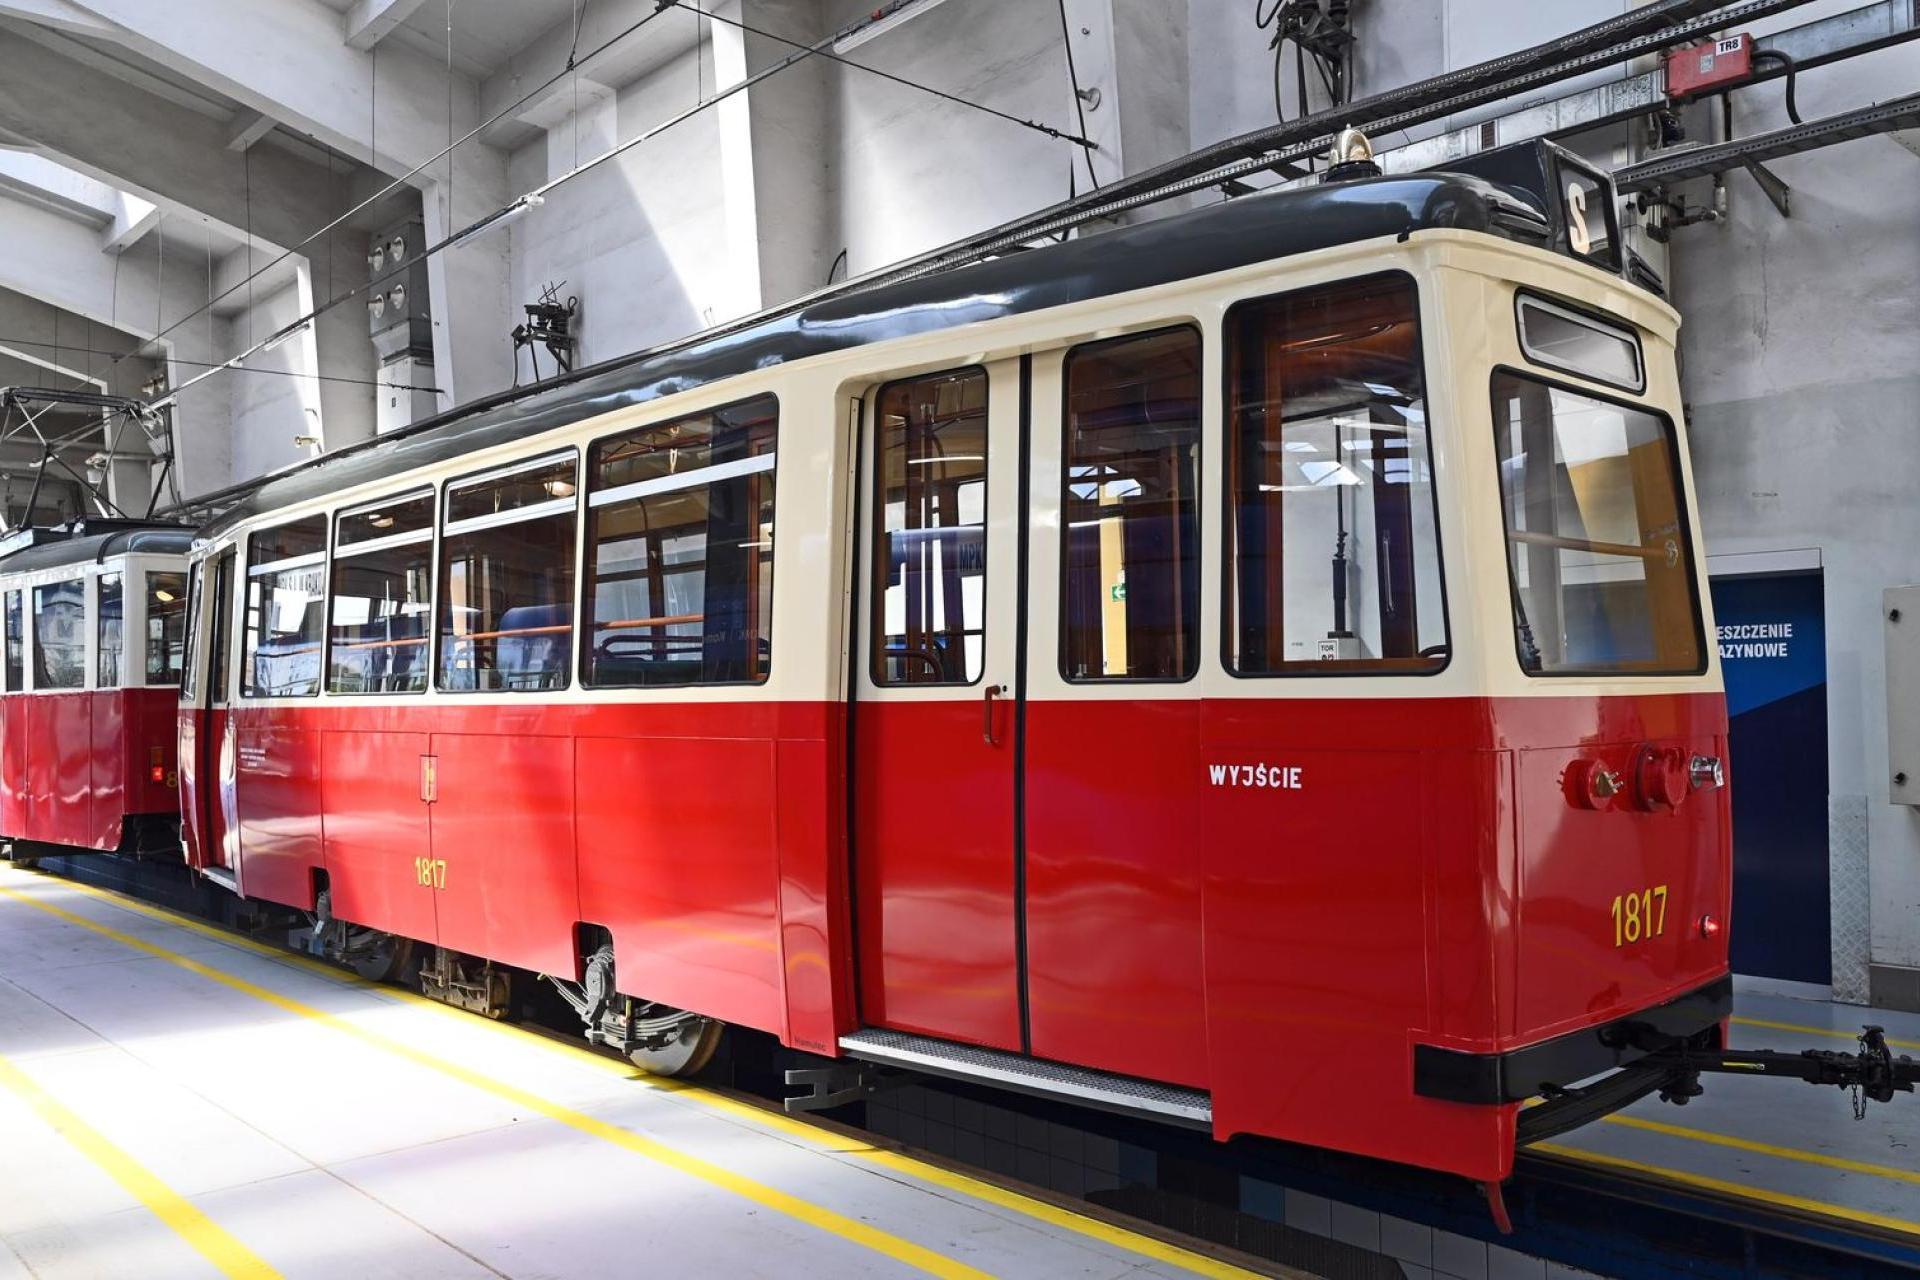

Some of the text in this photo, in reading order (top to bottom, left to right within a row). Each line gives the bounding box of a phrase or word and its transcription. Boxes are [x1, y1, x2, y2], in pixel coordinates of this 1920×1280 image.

[1720, 39, 1739, 52] TR8
[1568, 182, 1590, 254] S
[1209, 762, 1302, 789] WYJŚCIE
[414, 855, 447, 889] 1817
[1612, 885, 1667, 947] 1817
